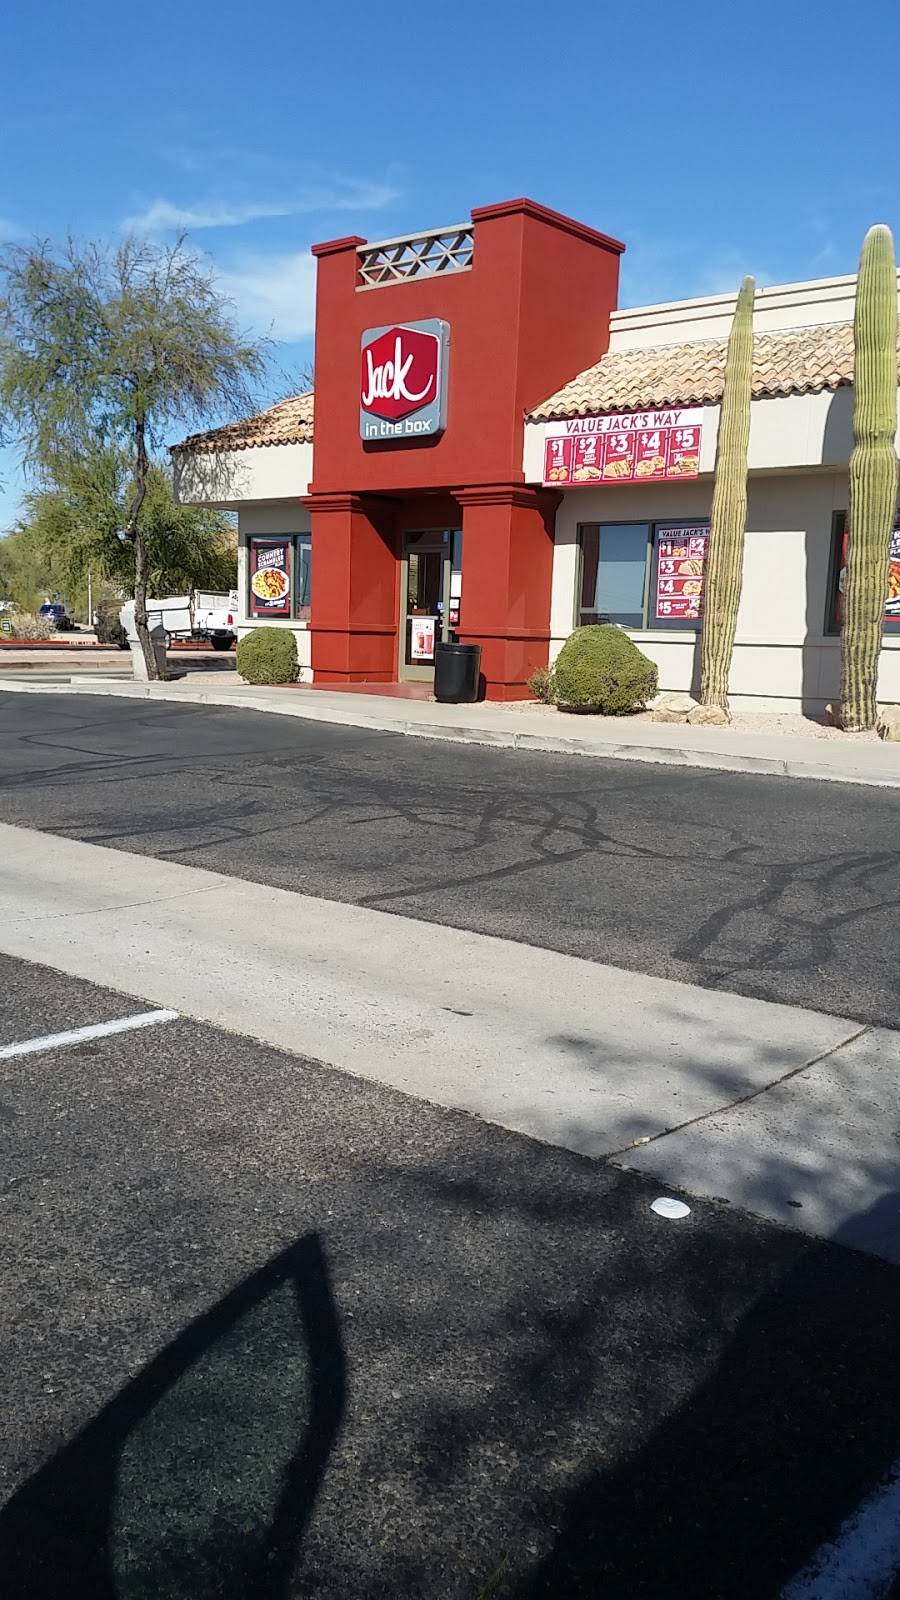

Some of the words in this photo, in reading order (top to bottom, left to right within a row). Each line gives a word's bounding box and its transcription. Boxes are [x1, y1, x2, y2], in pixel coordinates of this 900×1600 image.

[362, 336, 434, 406] Jack
[365, 423, 378, 436] in
[380, 421, 403, 435] the
[405, 419, 431, 433] box
[566, 418, 604, 434] VALUE
[607, 414, 649, 431] JACK'S
[653, 411, 682, 426] WAY
[551, 440, 564, 457] $1
[580, 437, 597, 454] $2
[610, 434, 629, 453] $3
[641, 431, 660, 449] $4
[675, 429, 694, 448] $5
[682, 528, 704, 537] JACK'S
[660, 541, 672, 555] $1
[691, 538, 705, 553] $2
[660, 560, 675, 574] $3
[659, 580, 674, 593] $4
[658, 601, 672, 614] $5
